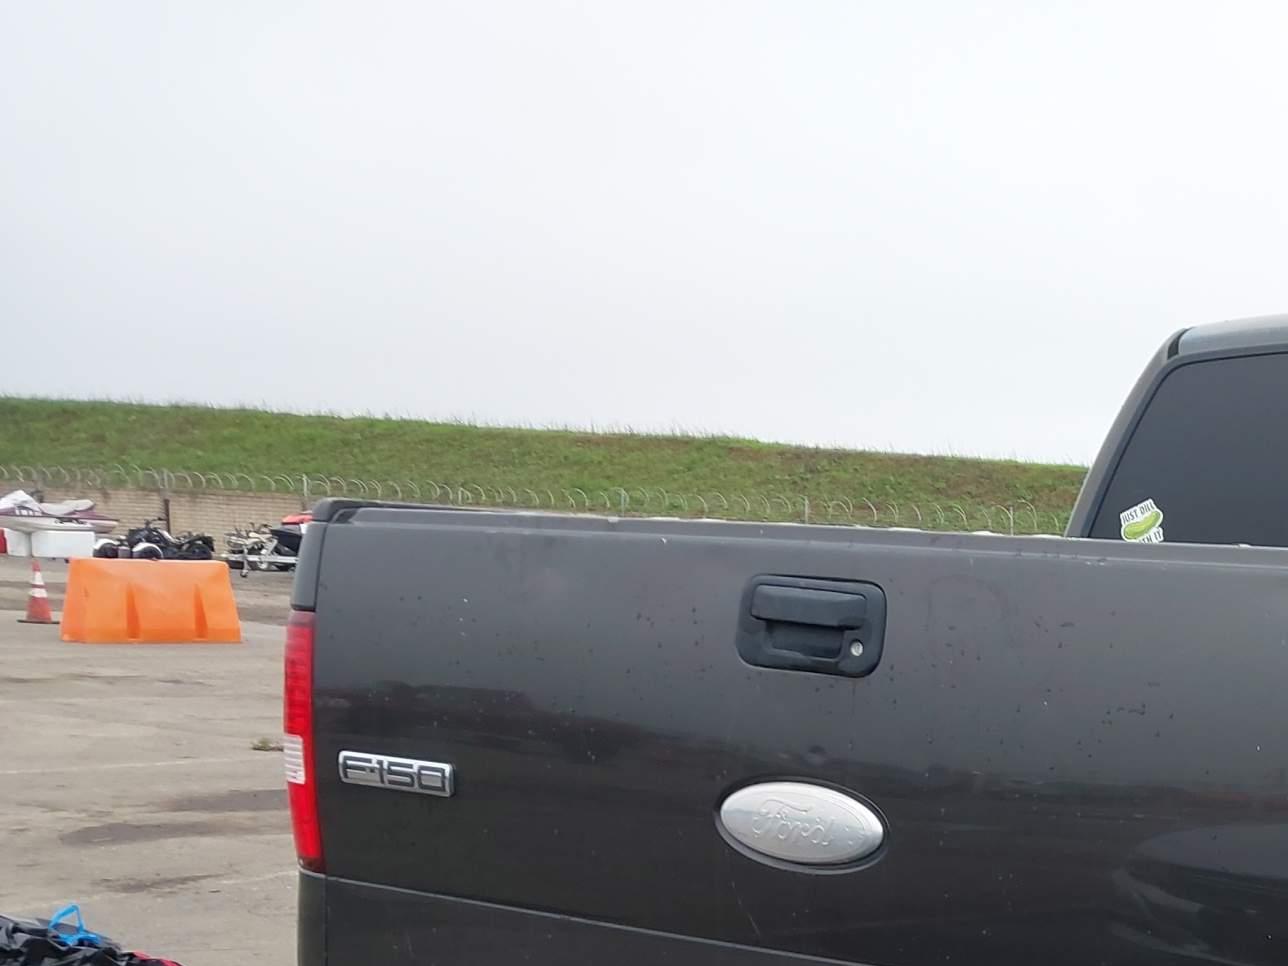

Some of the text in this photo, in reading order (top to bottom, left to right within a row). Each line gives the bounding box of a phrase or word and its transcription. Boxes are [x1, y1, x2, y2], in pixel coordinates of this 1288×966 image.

[1121, 501, 1156, 525] JUST DILL
[751, 799, 834, 846] Ford
